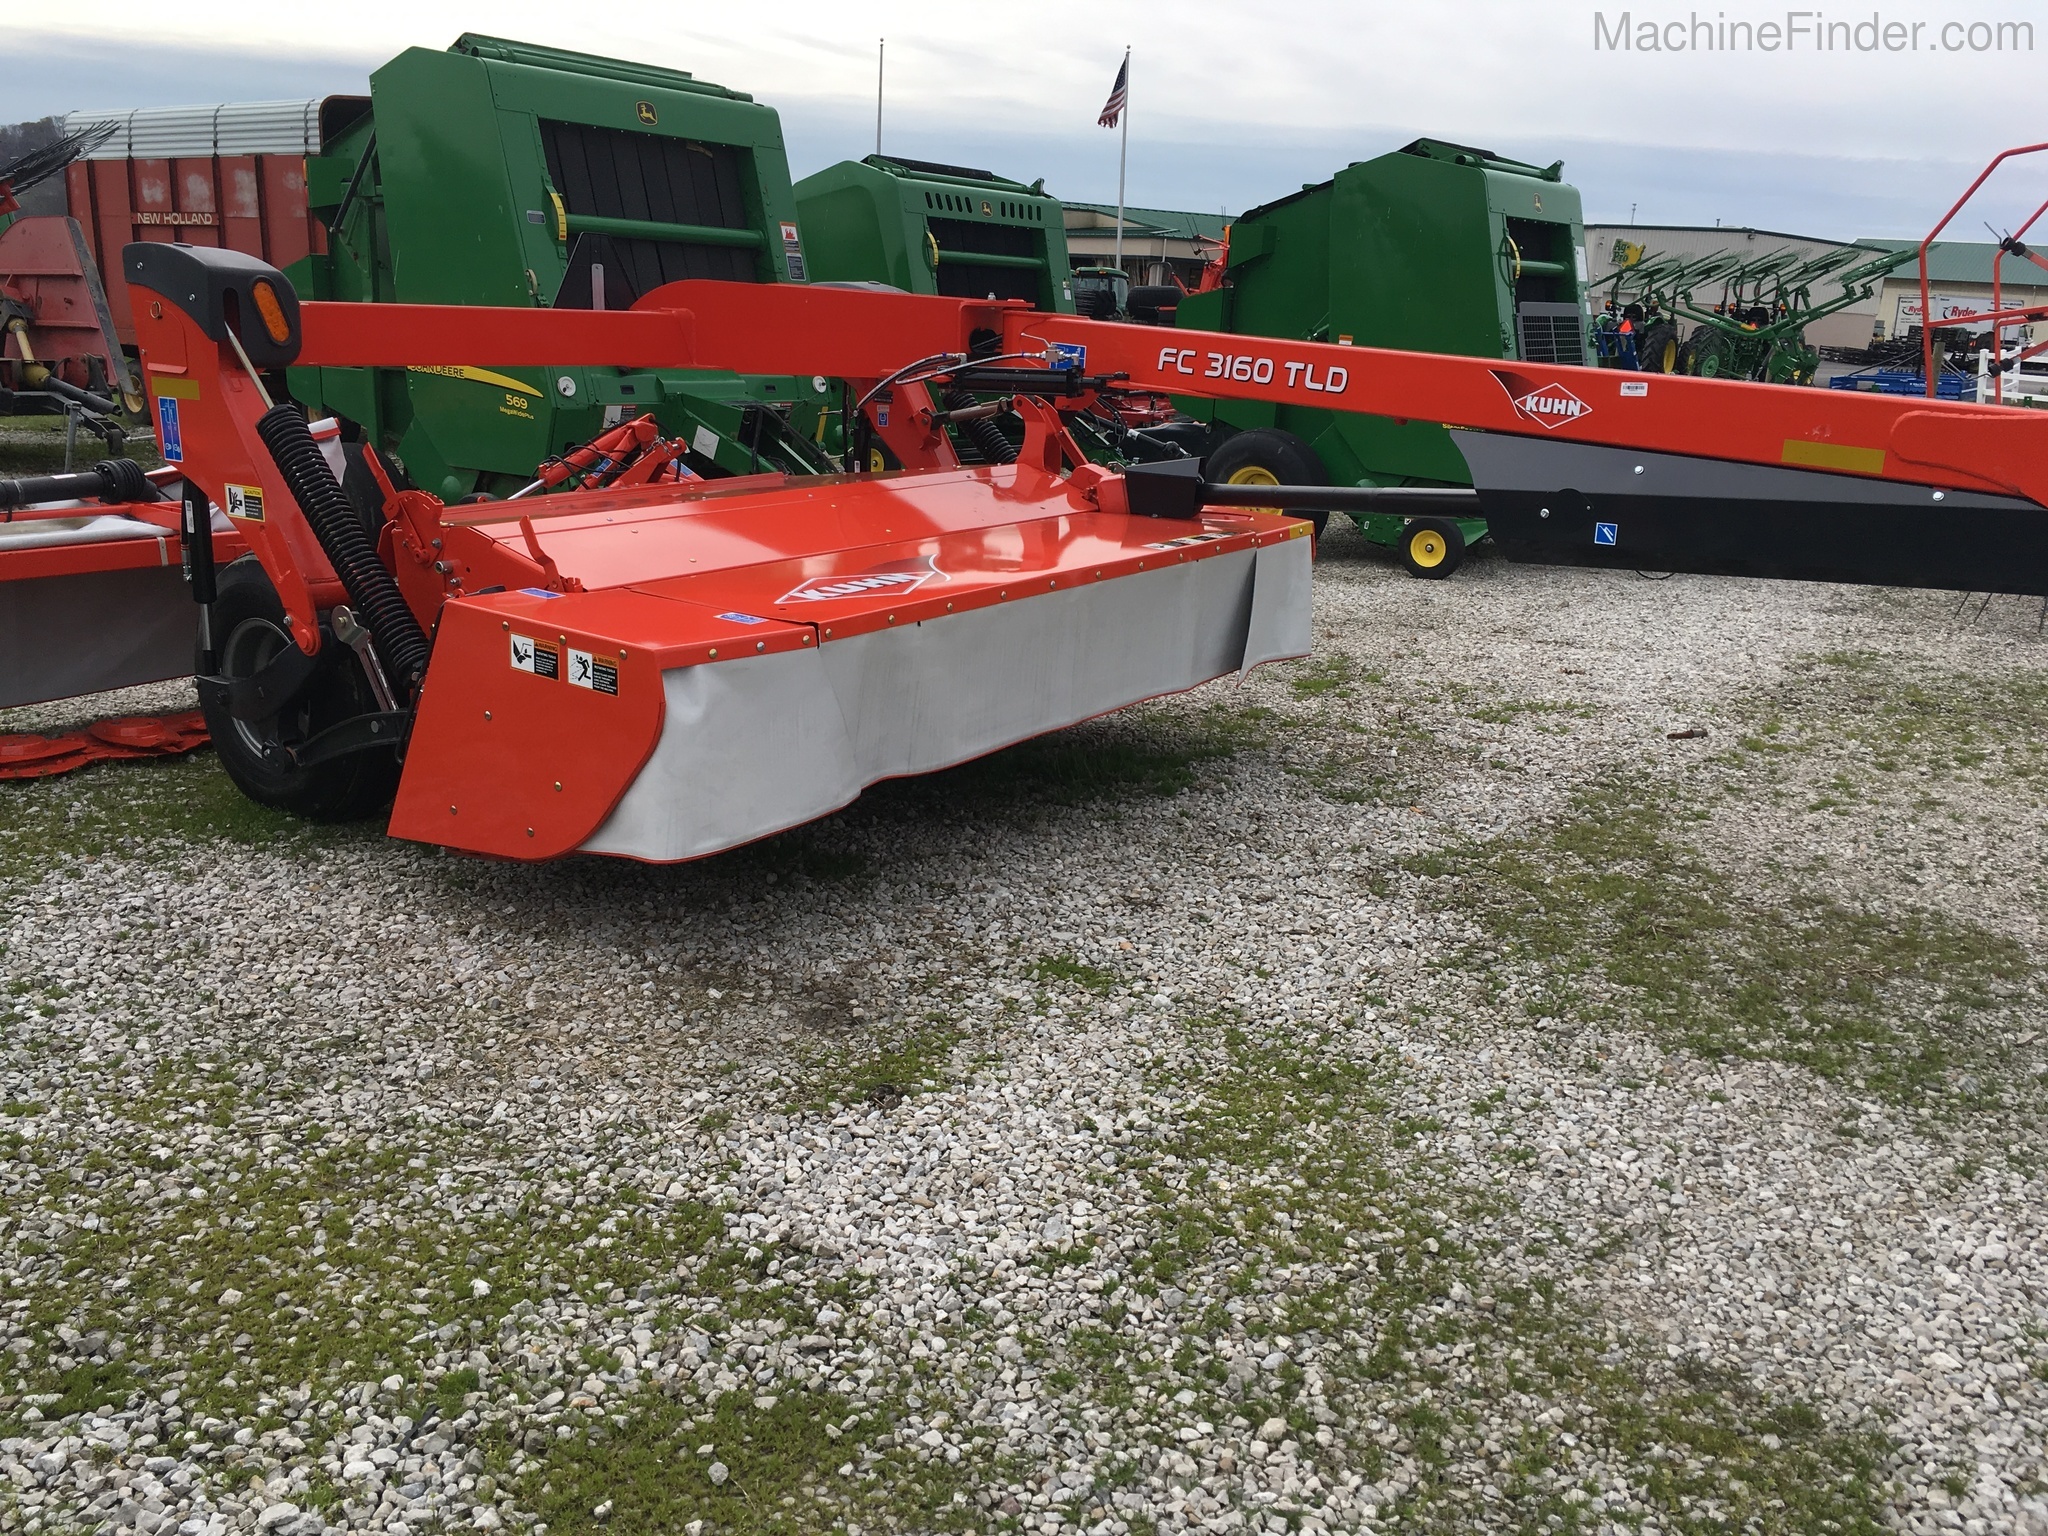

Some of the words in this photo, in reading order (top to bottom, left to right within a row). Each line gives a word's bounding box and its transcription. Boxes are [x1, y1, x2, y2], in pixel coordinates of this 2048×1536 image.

[138, 212, 161, 224] NEW
[163, 212, 213, 225] HOLLAND
[1951, 306, 1978, 317] Ryder
[1158, 347, 1196, 374] FC
[1204, 352, 1274, 384] 3160
[1284, 361, 1349, 394] TLD
[505, 394, 528, 409] 569
[1525, 395, 1582, 416] KUHN
[789, 573, 923, 601] KUHN
